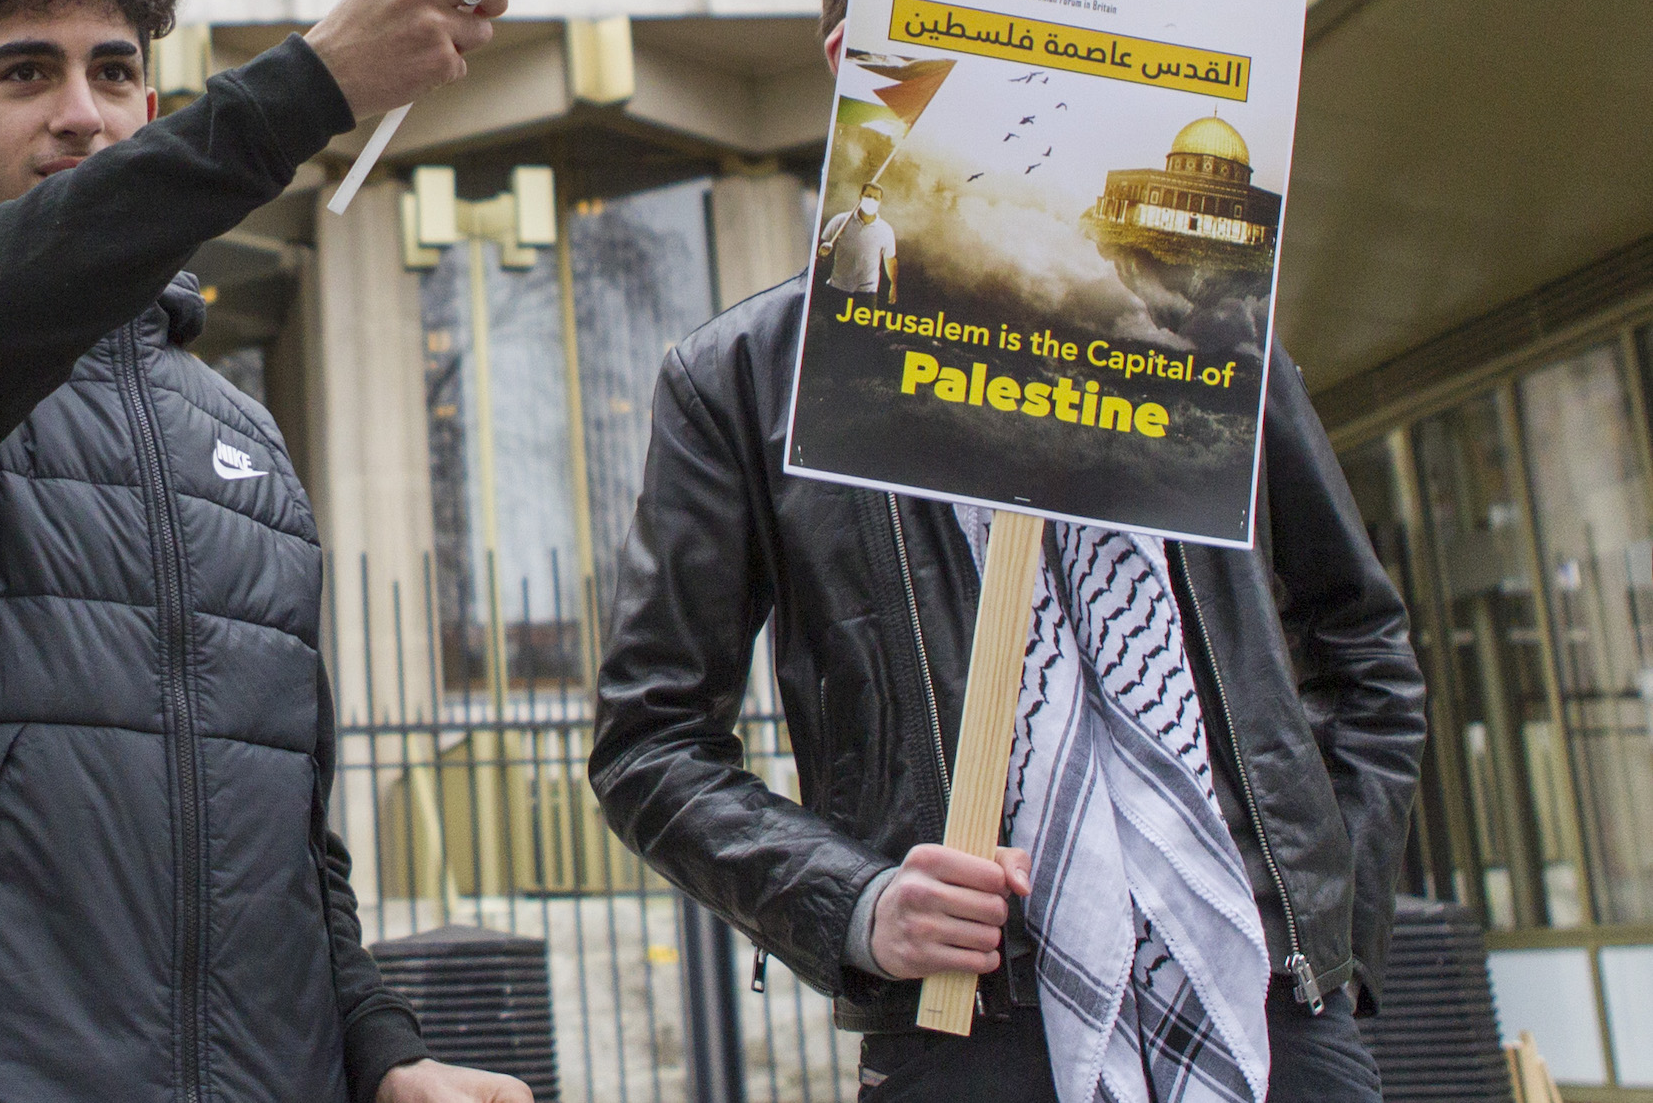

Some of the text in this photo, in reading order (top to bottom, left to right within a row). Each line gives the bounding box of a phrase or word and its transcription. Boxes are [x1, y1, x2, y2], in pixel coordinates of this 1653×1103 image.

[1083, 0, 1090, 9] in
[1092, 0, 1117, 14] Britain
[904, 11, 1242, 87] القدس عاصمة فلسطين
[835, 297, 1236, 388] Jerusalem is the Capital of
[900, 350, 1171, 439] Palestine
[216, 438, 254, 471] NIKE
